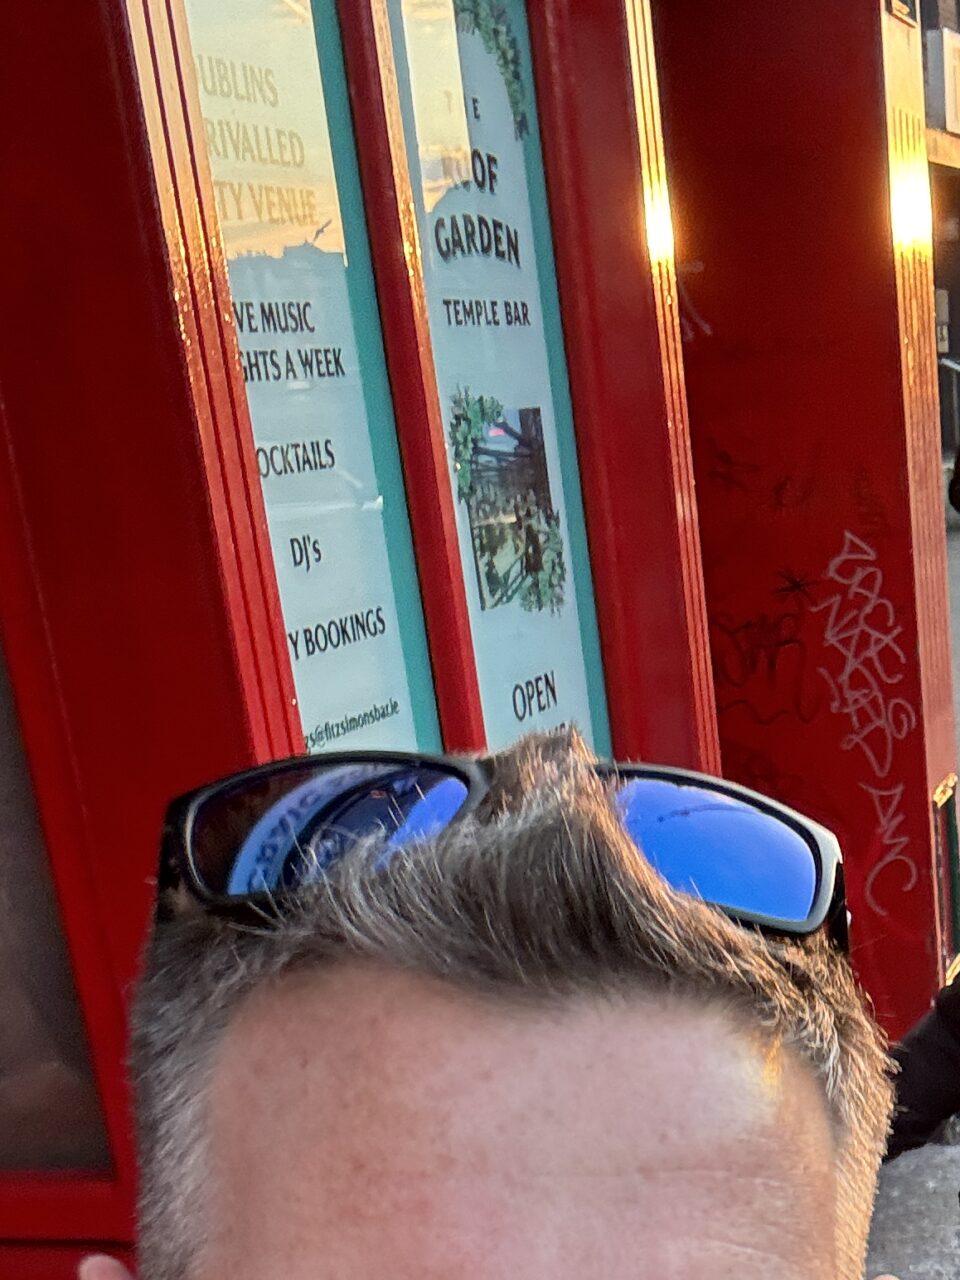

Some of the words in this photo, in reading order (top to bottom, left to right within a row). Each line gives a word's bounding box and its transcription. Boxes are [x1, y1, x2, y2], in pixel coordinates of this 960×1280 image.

[248, 181, 320, 227] VENUE
[434, 213, 521, 268] GARDEN
[260, 301, 315, 333] MUSIC
[442, 299, 500, 327] TEMPLE
[504, 301, 531, 327] BAR
[285, 350, 297, 381] A
[298, 347, 345, 378] WEEK
[256, 439, 335, 479] OCKTAILS
[289, 534, 322, 573] DJ's
[303, 606, 386, 657] BOOKINGS
[512, 670, 558, 722] OPEN
